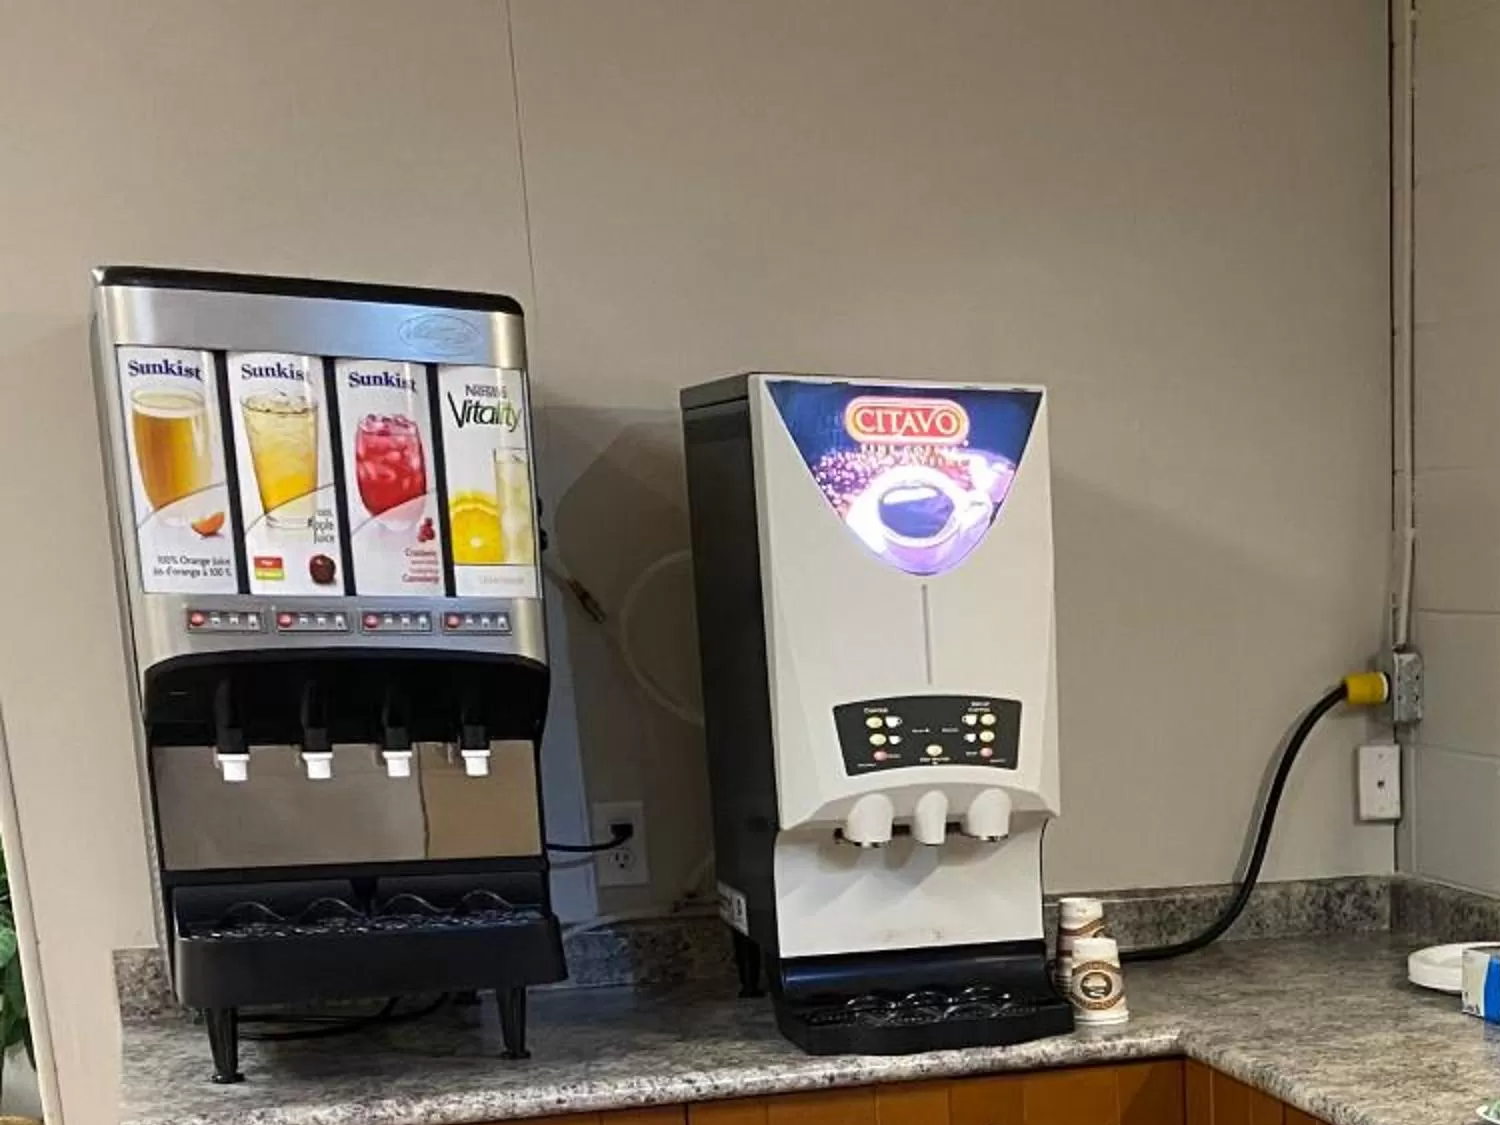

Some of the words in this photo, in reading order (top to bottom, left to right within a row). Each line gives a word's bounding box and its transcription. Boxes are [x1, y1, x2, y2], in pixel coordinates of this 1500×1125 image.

[127, 358, 202, 381] Sunkist
[241, 361, 312, 384] Sunkis
[447, 391, 522, 432] Vitality
[854, 406, 959, 436] CITAVO
